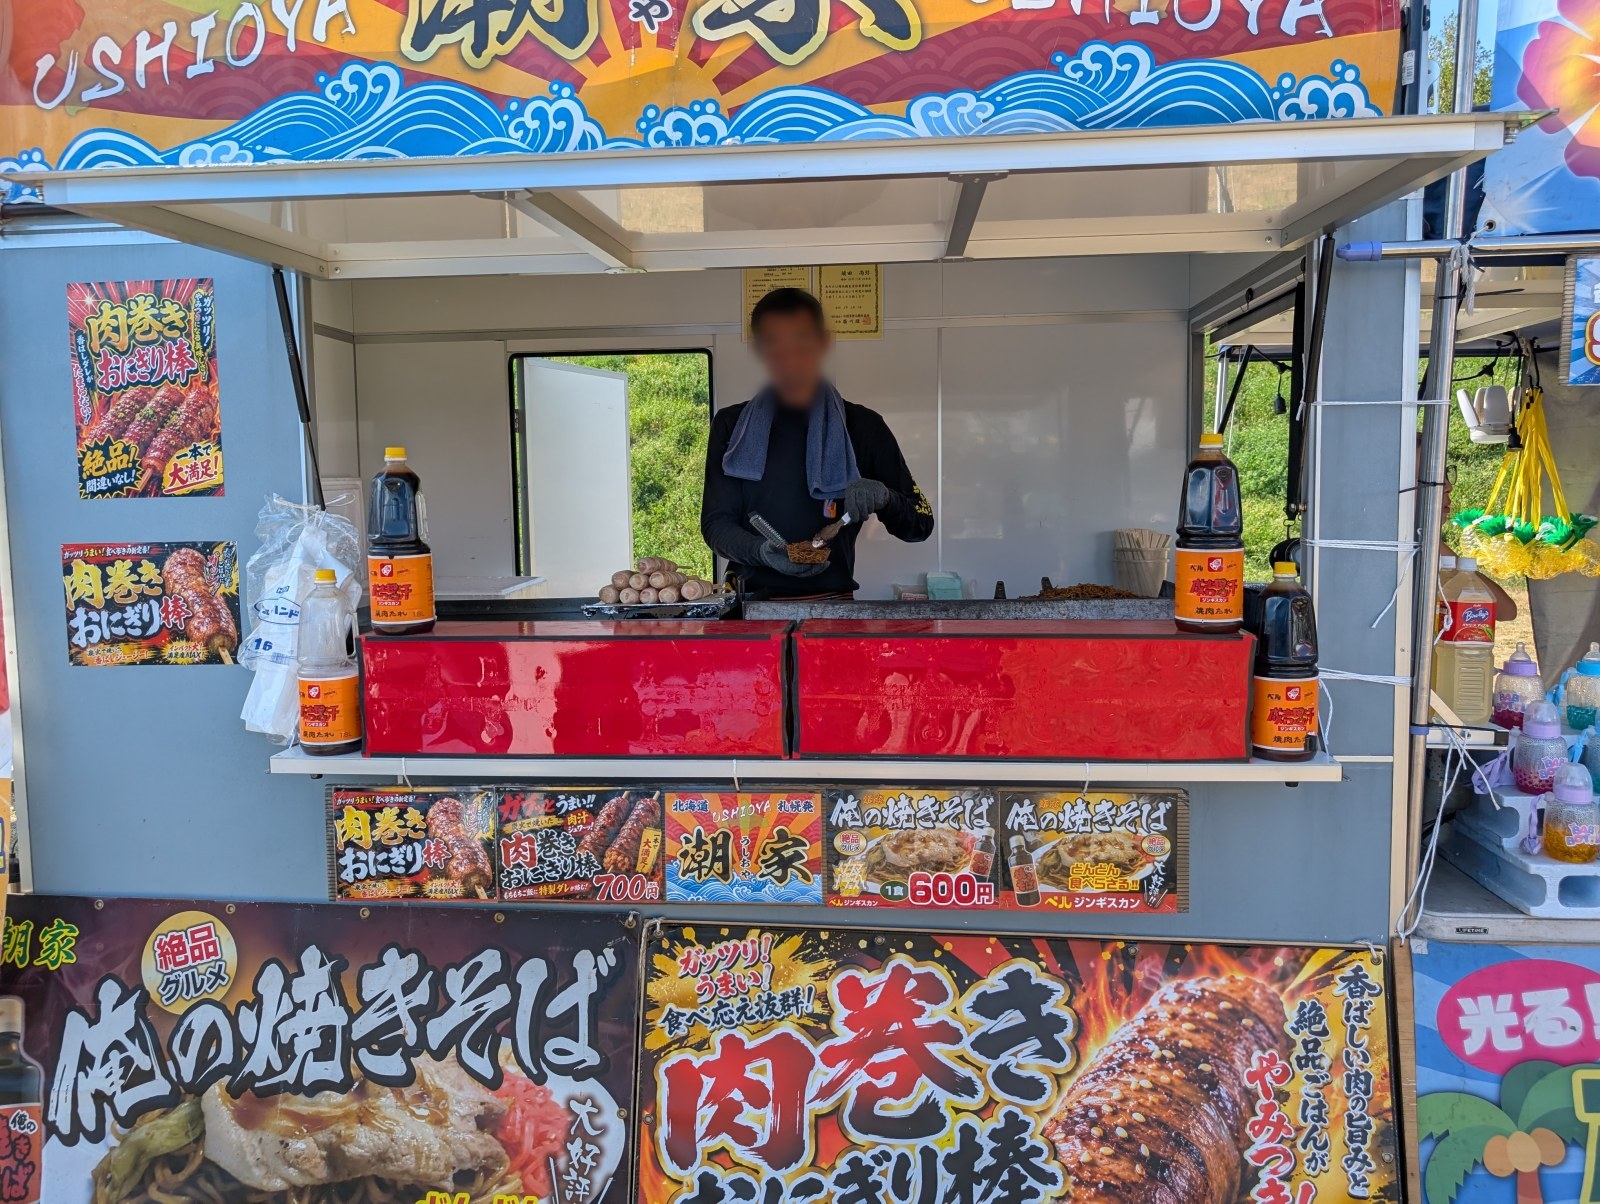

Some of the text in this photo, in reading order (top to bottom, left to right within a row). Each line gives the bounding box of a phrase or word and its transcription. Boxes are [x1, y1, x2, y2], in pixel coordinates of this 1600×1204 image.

[33, 0, 356, 110] USHIOYA
[87, 295, 188, 354] 肉巻き
[97, 339, 197, 390] おにぎり棒
[82, 442, 137, 478] 絶品!
[168, 457, 219, 488] 大満足!
[176, 443, 211, 461] 一本で
[86, 471, 136, 493] 間違いなし!
[63, 559, 163, 611] 肉巻き
[69, 594, 192, 648] おにぎり棒
[254, 637, 274, 651] 16
[1273, 735, 1304, 744] 焼肉た
[334, 805, 427, 850] 肉巻き
[567, 811, 589, 826] 肉汁
[672, 799, 814, 823] 北海道 USHIOYA 札幌発
[829, 793, 994, 831] 俺の焼きそば
[1004, 797, 1172, 833] 俺の焼きそば
[338, 837, 452, 883] おにぎり棒
[500, 829, 577, 870] 肉巻き
[500, 849, 603, 890] おにぎり棒
[641, 838, 654, 872] 大満足!
[740, 836, 753, 880] うしおや
[756, 825, 815, 887] 家
[1070, 863, 1120, 877] どんどん
[593, 873, 660, 901] 700円
[885, 872, 995, 906] 1食 600円
[1045, 896, 1140, 909] ベル ジンギスカン
[1069, 877, 1140, 892] 食べらさる!!
[154, 923, 221, 974] 絶品
[679, 934, 773, 976] ガッツリ!
[160, 963, 230, 1006] グルメ
[695, 962, 774, 1002] うまい!
[661, 986, 816, 1036] 食べ応え抜群!
[49, 945, 616, 1137] 俺の焼きそば
[662, 960, 1070, 1174] 肉巻き
[1290, 1000, 1332, 1174] 絶品ごはんが
[1338, 964, 1382, 1198] 香ばしい肉の旨みと
[9, 1110, 37, 1133] 俺の
[563, 1099, 604, 1202] 大好評
[0, 1161, 36, 1202] ば
